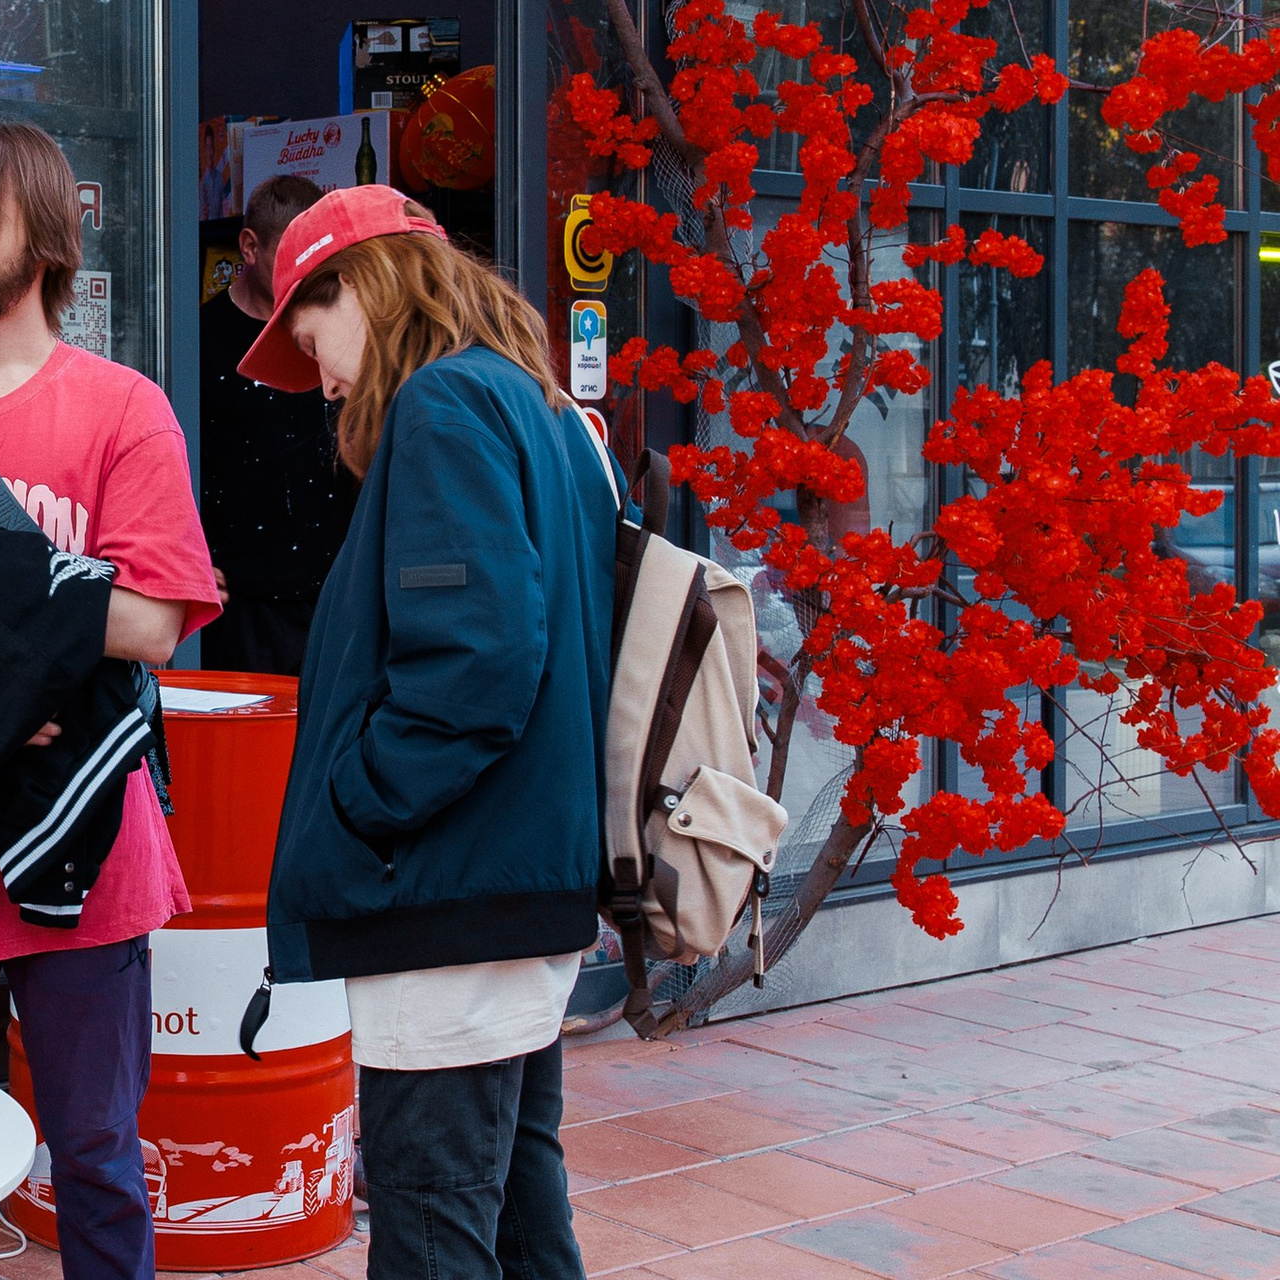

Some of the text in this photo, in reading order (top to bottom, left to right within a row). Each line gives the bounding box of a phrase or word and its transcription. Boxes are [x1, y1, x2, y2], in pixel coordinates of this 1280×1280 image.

[385, 74, 429, 85] STOUT
[287, 128, 320, 146] Lucky
[277, 144, 325, 166] Buddha
[581, 354, 598, 362] Здесь
[577, 362, 602, 370] хорошо!
[580, 384, 598, 393] 2ГИС
